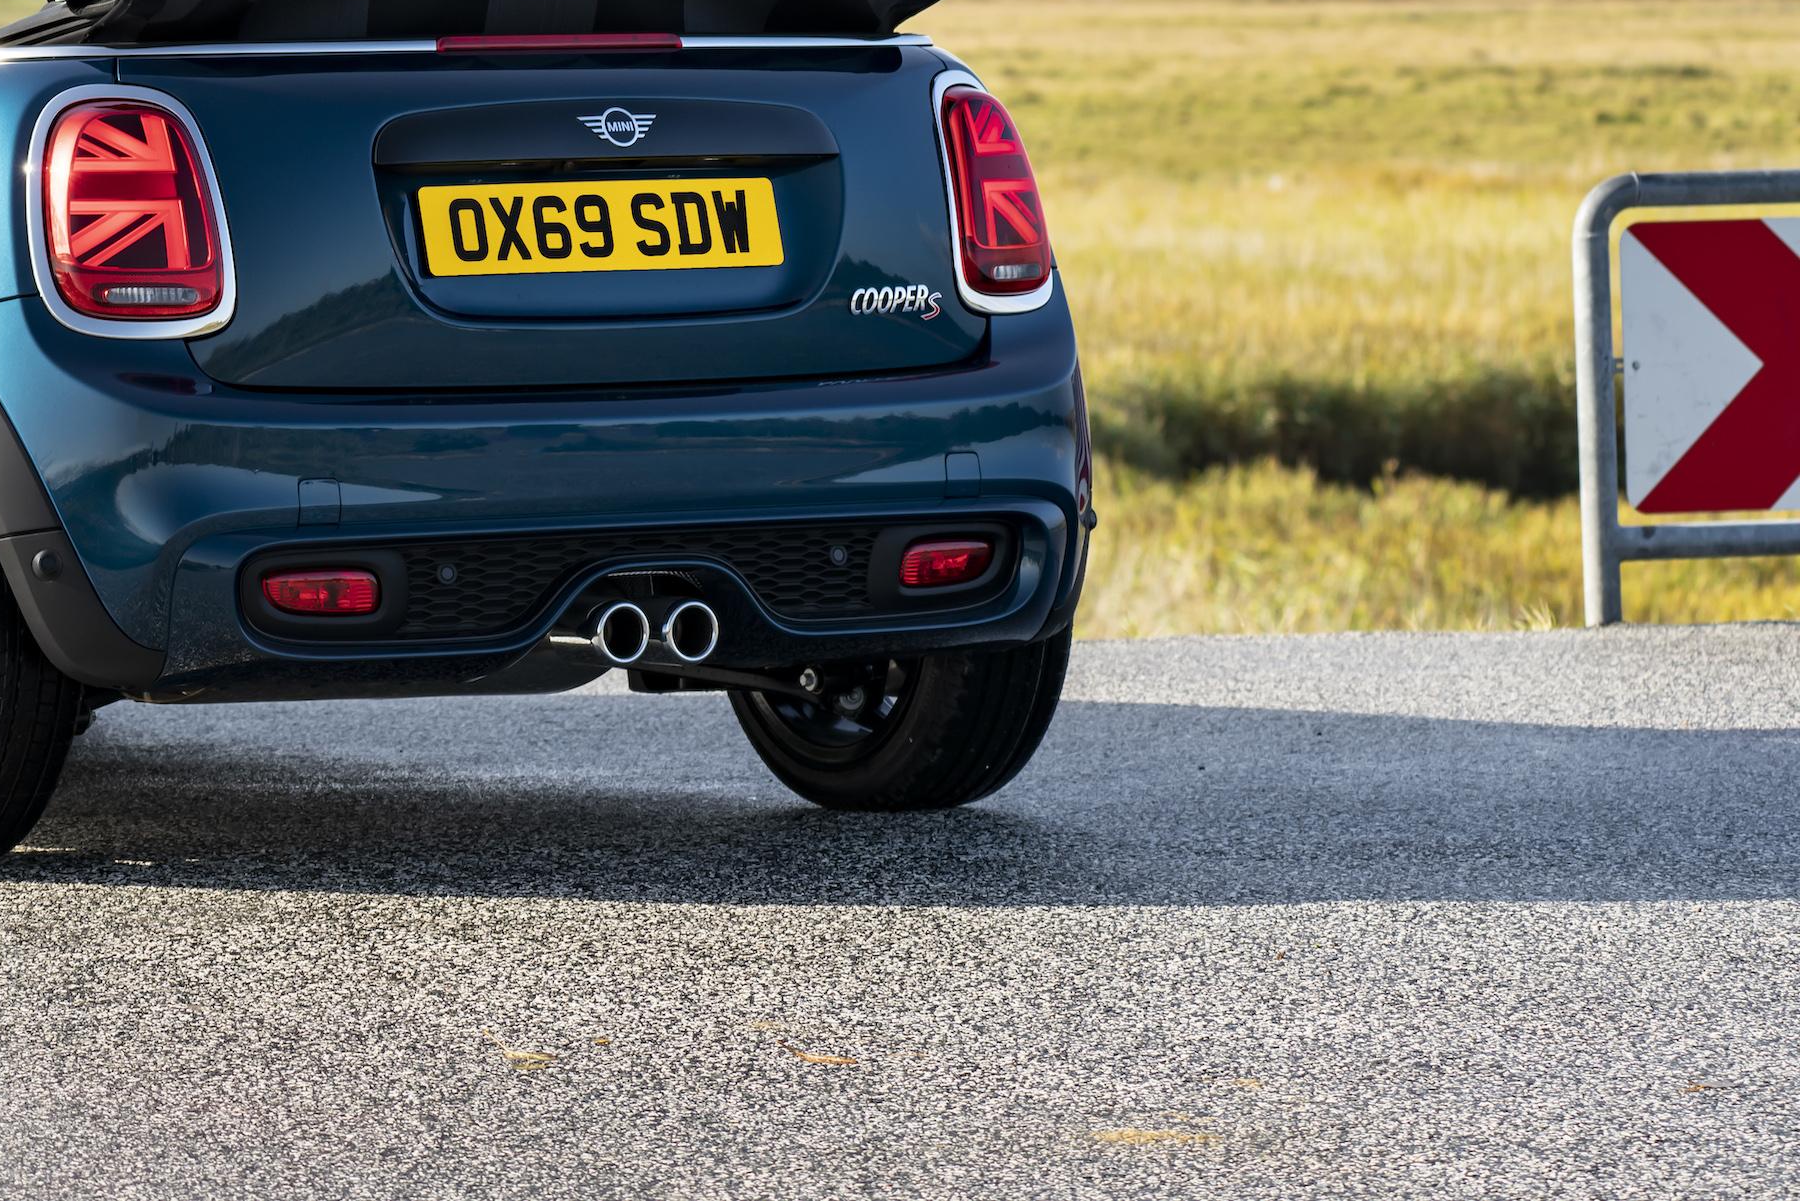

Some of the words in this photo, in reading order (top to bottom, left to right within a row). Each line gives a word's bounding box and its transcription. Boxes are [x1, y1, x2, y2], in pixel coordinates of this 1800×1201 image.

[605, 120, 635, 132] MINI
[448, 194, 615, 262] OX69
[630, 189, 751, 257] SDW
[850, 284, 929, 316] COOPER
[920, 291, 943, 320] S
